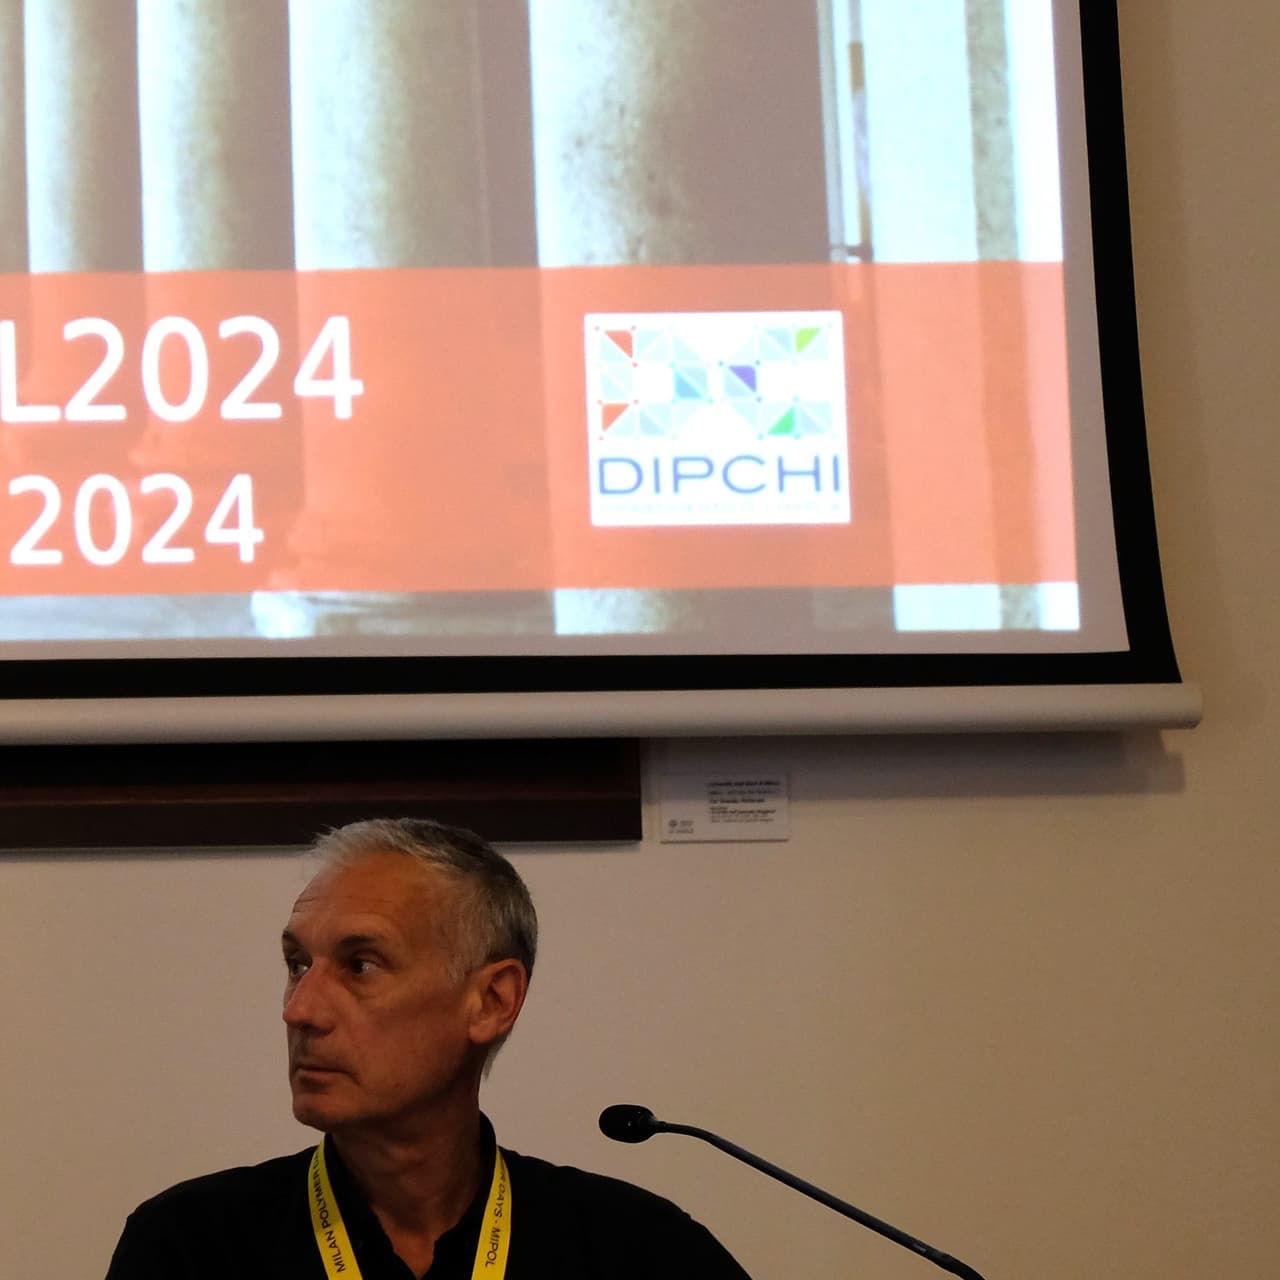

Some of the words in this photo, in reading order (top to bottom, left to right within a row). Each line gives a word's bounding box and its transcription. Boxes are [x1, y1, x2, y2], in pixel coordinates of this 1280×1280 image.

[598, 454, 842, 496] DIPCHI
[8, 472, 266, 570] 2024
[312, 1172, 331, 1230] POLYMER
[324, 1229, 347, 1274] MILAN
[485, 1227, 501, 1268] MIPOL
